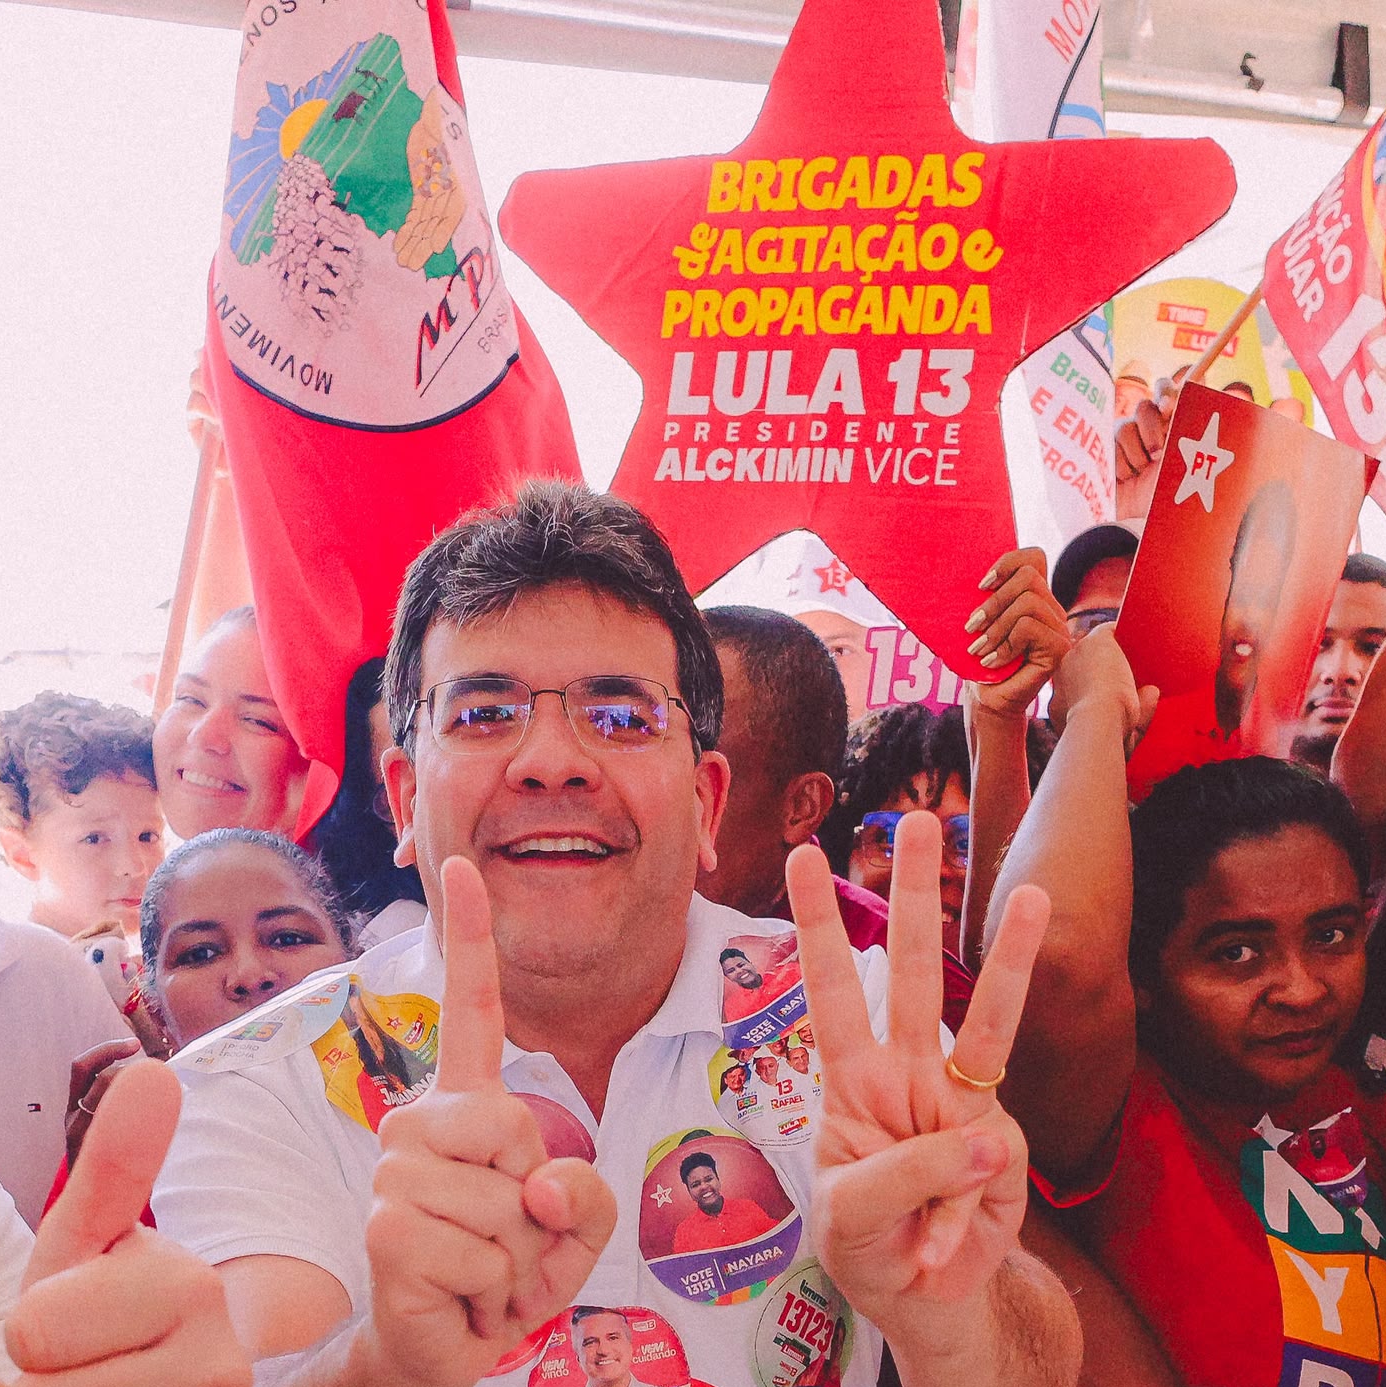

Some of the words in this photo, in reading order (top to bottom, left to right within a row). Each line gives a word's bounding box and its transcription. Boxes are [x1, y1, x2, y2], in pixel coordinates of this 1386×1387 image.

[707, 152, 985, 213] BRIGADAS
[673, 222, 718, 280] de
[710, 211, 960, 283] AGITAÇÃO
[963, 229, 1004, 272] e
[1281, 214, 1326, 324] UIAR
[661, 284, 992, 338] PROPAGANDA
[667, 348, 866, 416] LULA
[887, 349, 974, 417] 13
[663, 421, 960, 444] PRESIDENTE
[654, 448, 854, 482] ALCKIMIN
[865, 448, 961, 486] VICE
[1191, 451, 1218, 481] PT
[826, 568, 846, 587] 13
[741, 1018, 771, 1041] VOTE
[775, 1078, 794, 1096] 13
[770, 1094, 806, 1110] RAFAEL
[724, 1245, 784, 1276] NAYARA
[680, 1267, 714, 1287] VOTE
[685, 1278, 716, 1297] 13131
[777, 1292, 834, 1354] 13123
[632, 1348, 677, 1364] cuidando
[541, 1368, 570, 1380] vindo
